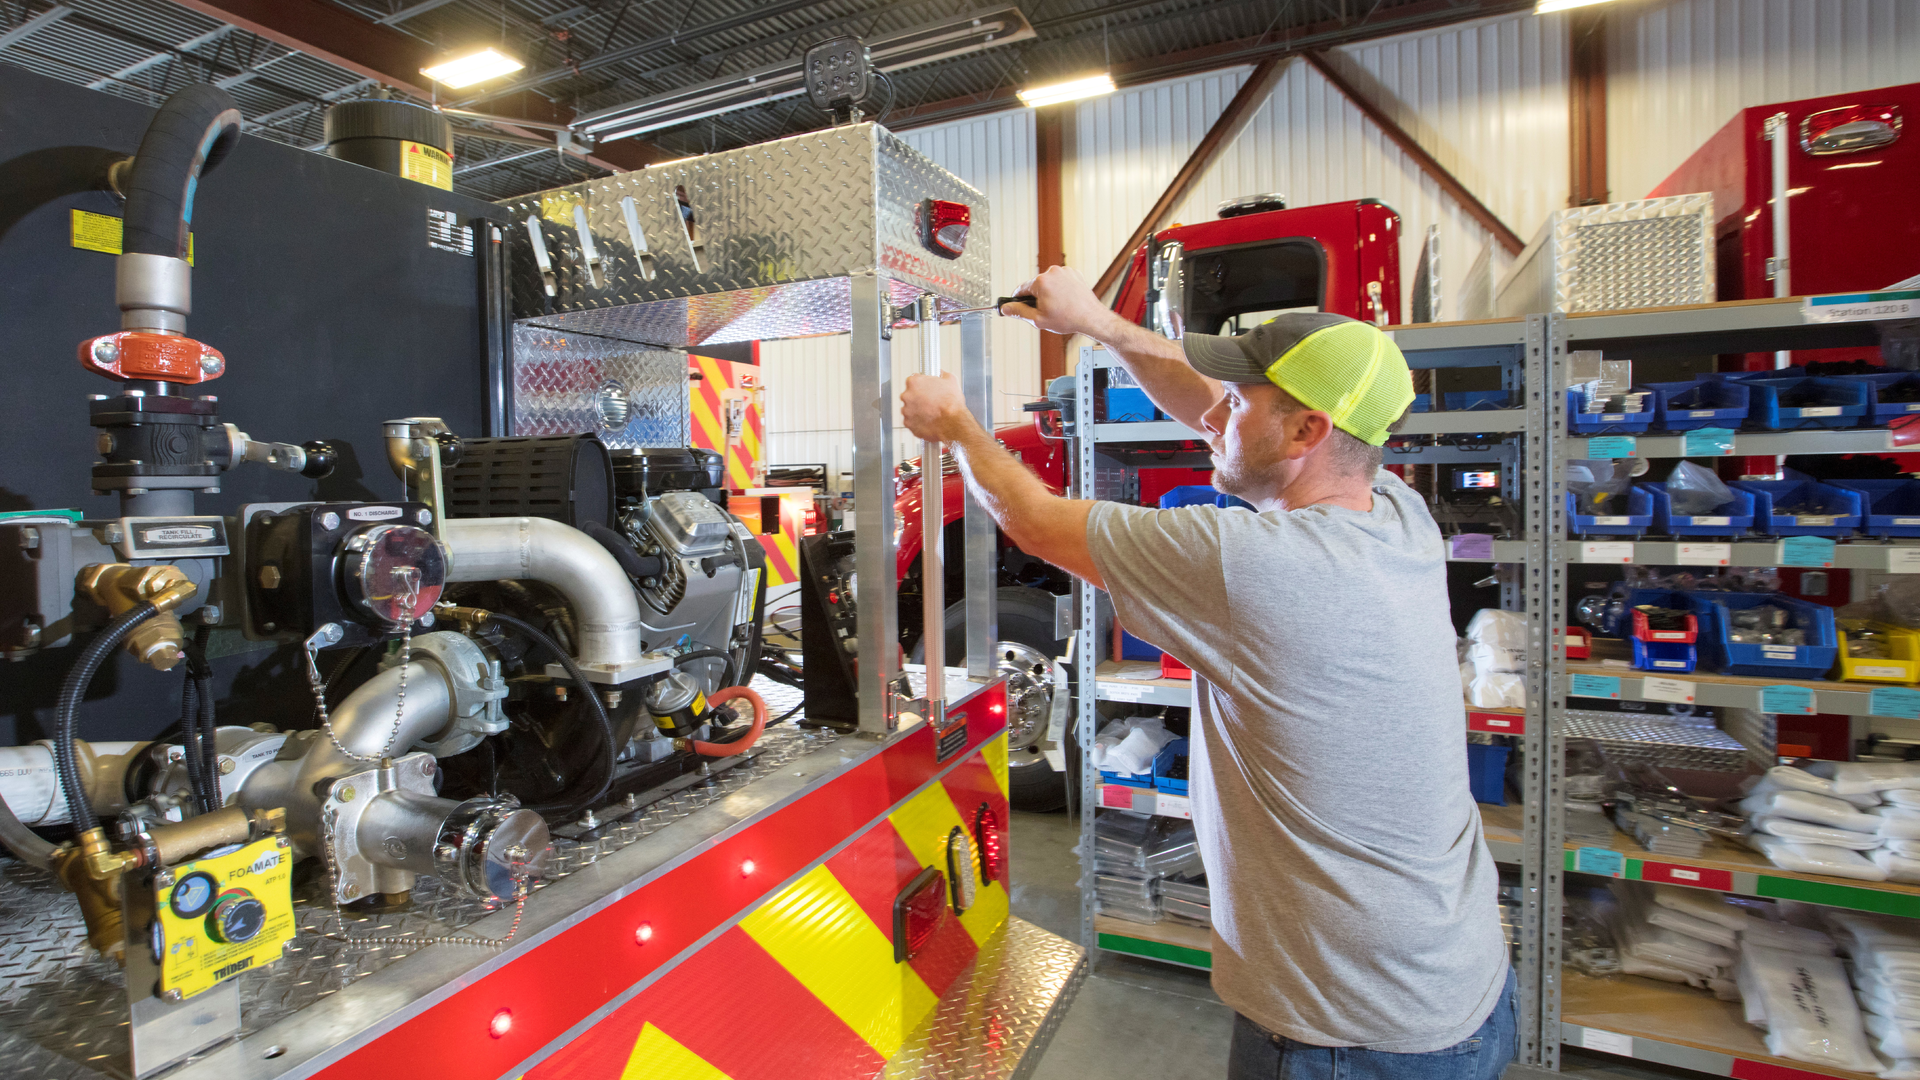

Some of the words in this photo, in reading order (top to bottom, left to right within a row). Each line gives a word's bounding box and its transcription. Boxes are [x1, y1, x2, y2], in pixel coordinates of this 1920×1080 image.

[1829, 307, 1871, 317] Station
[1874, 304, 1898, 315] 120
[252, 751, 266, 759] TANK
[265, 876, 277, 885] ATP
[277, 873, 286, 881] 1.0
[213, 955, 255, 981] TRIDENT
